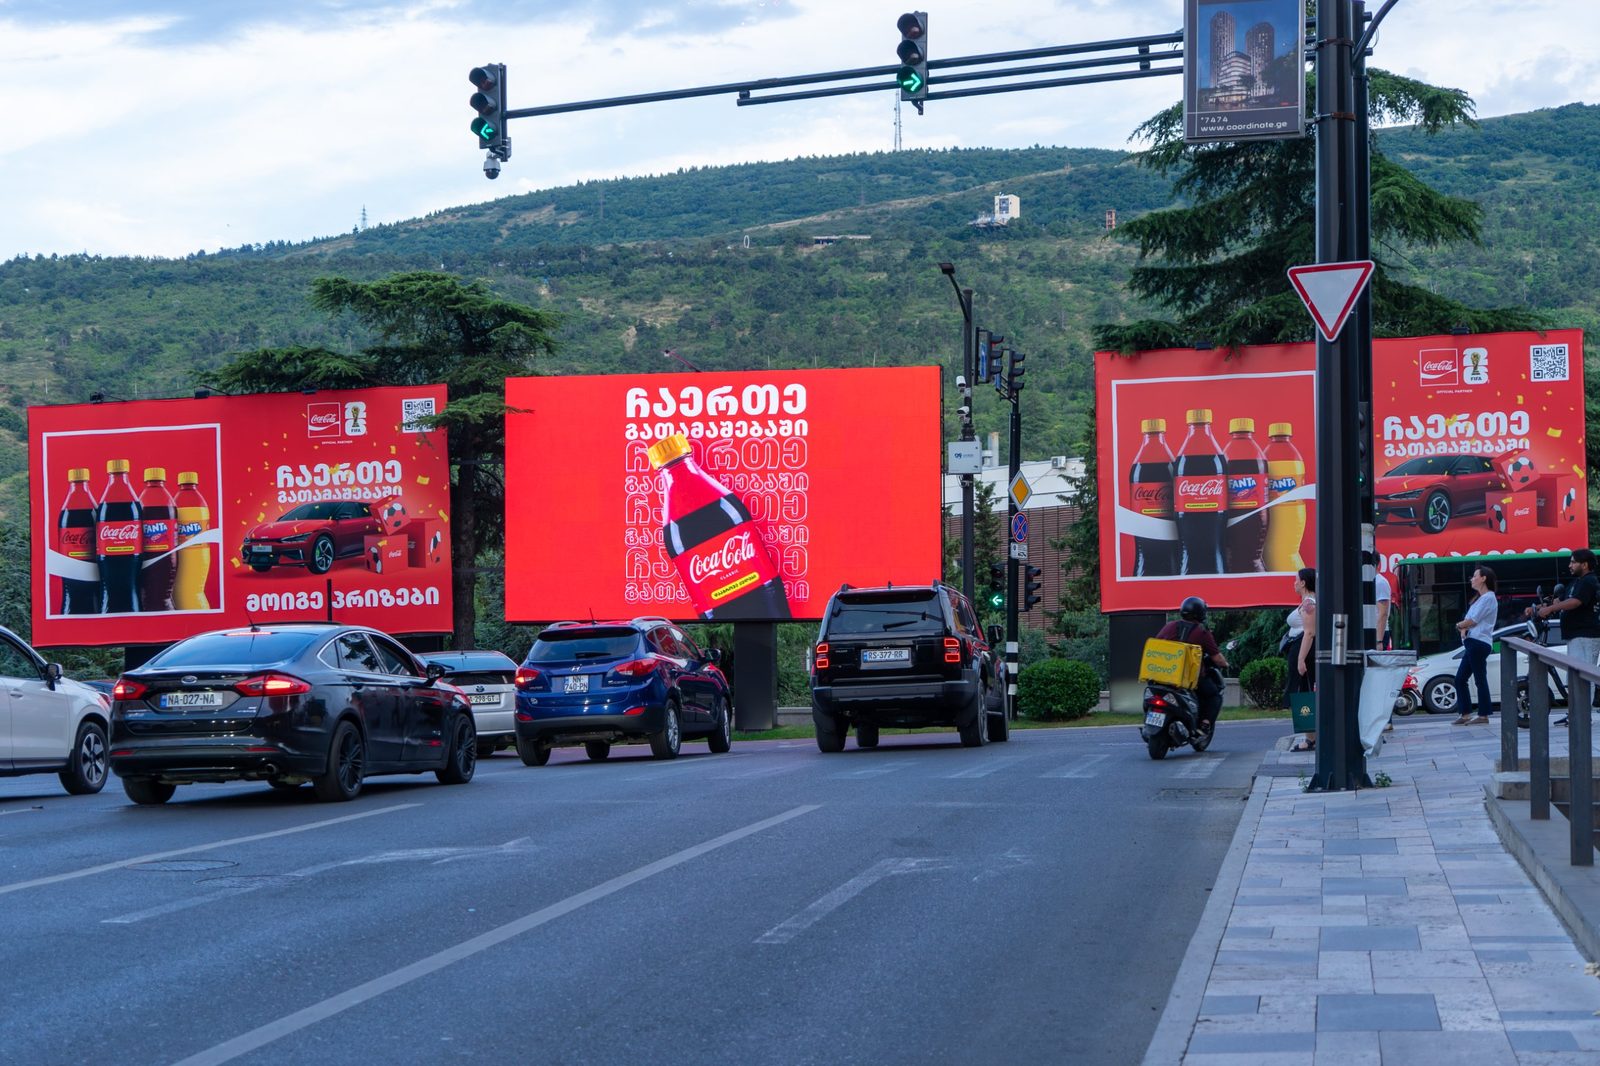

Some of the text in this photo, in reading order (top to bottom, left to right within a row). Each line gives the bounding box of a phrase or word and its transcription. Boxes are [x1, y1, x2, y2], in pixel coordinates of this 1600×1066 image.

[1200, 121, 1288, 132] www.coordinate.ge
[1423, 360, 1454, 372] Coca-Cola
[625, 383, 807, 418] ჩაერთე
[311, 413, 337, 424] Coca-Cola
[1383, 410, 1530, 441] ჩაერთე
[276, 459, 402, 489] ჩაერთე
[1179, 479, 1224, 496] Coca-Cola
[1228, 477, 1257, 489] FANTA
[1269, 477, 1296, 489] FANTA
[100, 524, 139, 540] Coca-Cola
[143, 522, 168, 534] FANTA
[178, 522, 202, 533] FANTA
[689, 531, 756, 584] Coca-Cola
[719, 569, 740, 581] CLASSIC
[246, 586, 440, 612] მოიგე პრიზები
[868, 651, 903, 659] RS-377-RR
[168, 694, 215, 705] NA-027-NA
